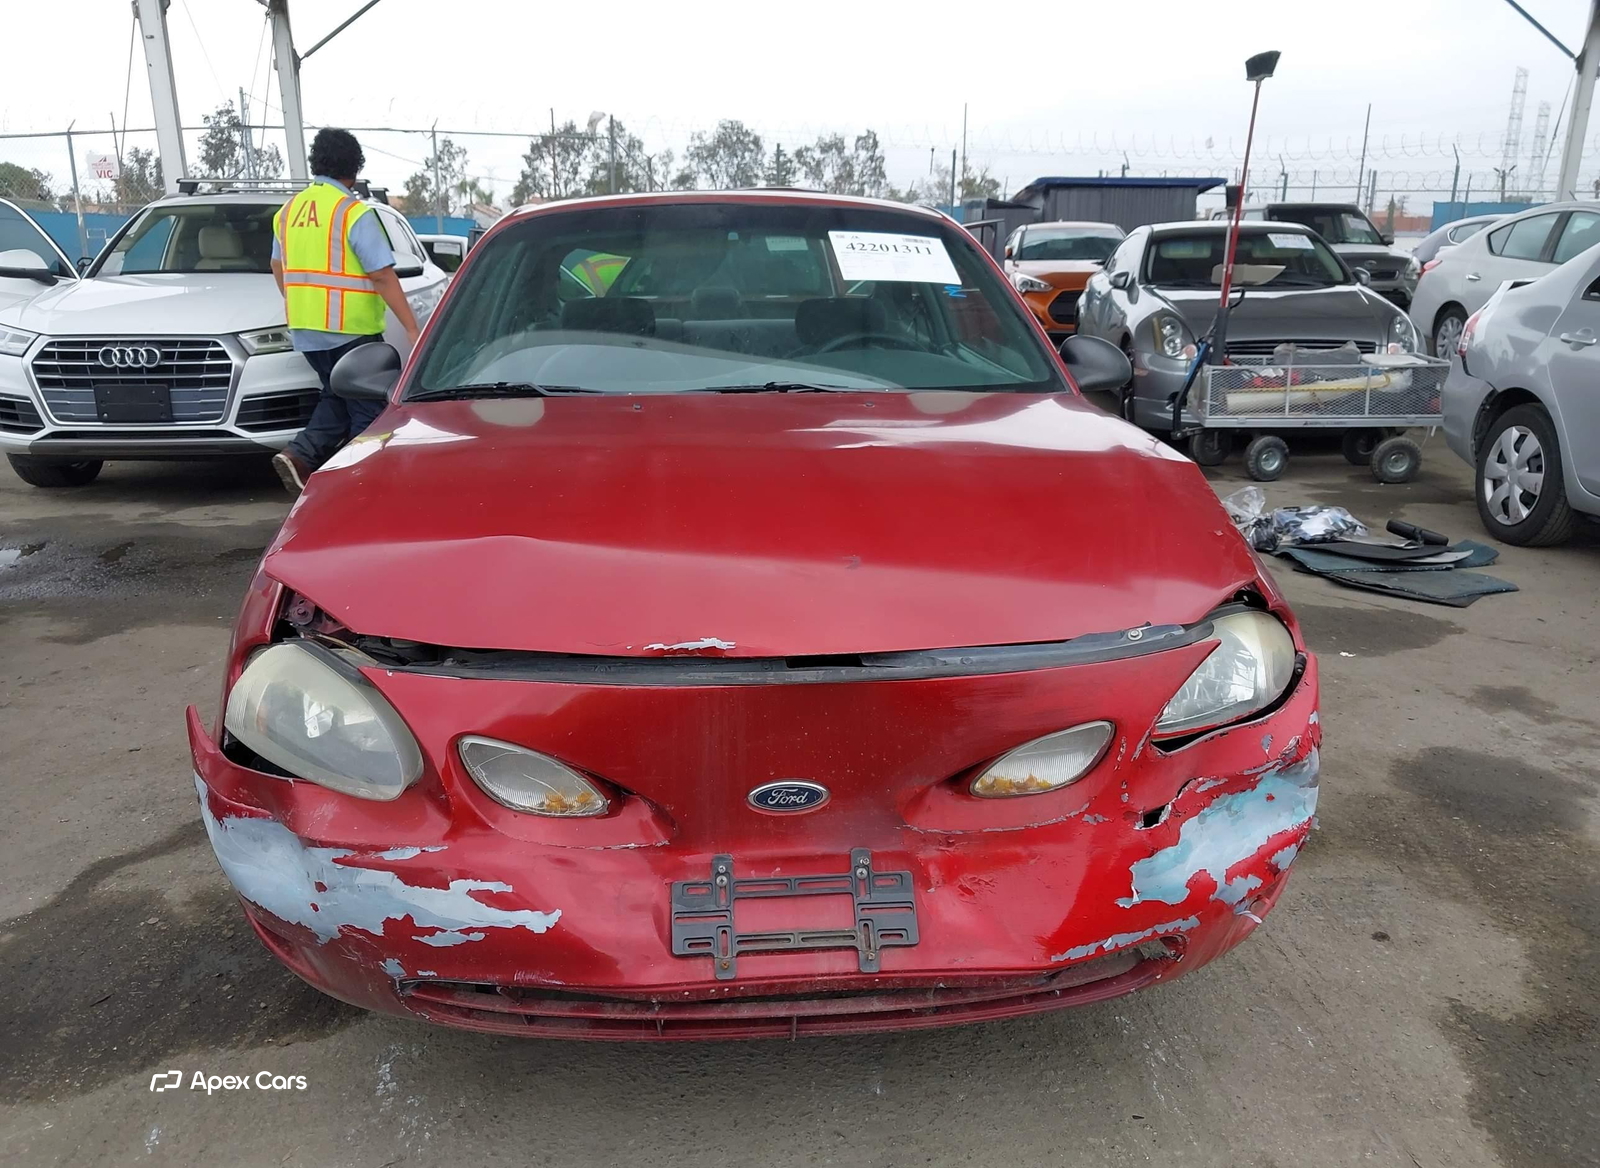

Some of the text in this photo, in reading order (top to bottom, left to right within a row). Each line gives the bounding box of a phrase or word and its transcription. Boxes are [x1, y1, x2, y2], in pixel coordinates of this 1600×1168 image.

[96, 170, 113, 178] VIC
[845, 242, 932, 255] 42201311
[767, 788, 809, 805] Ford
